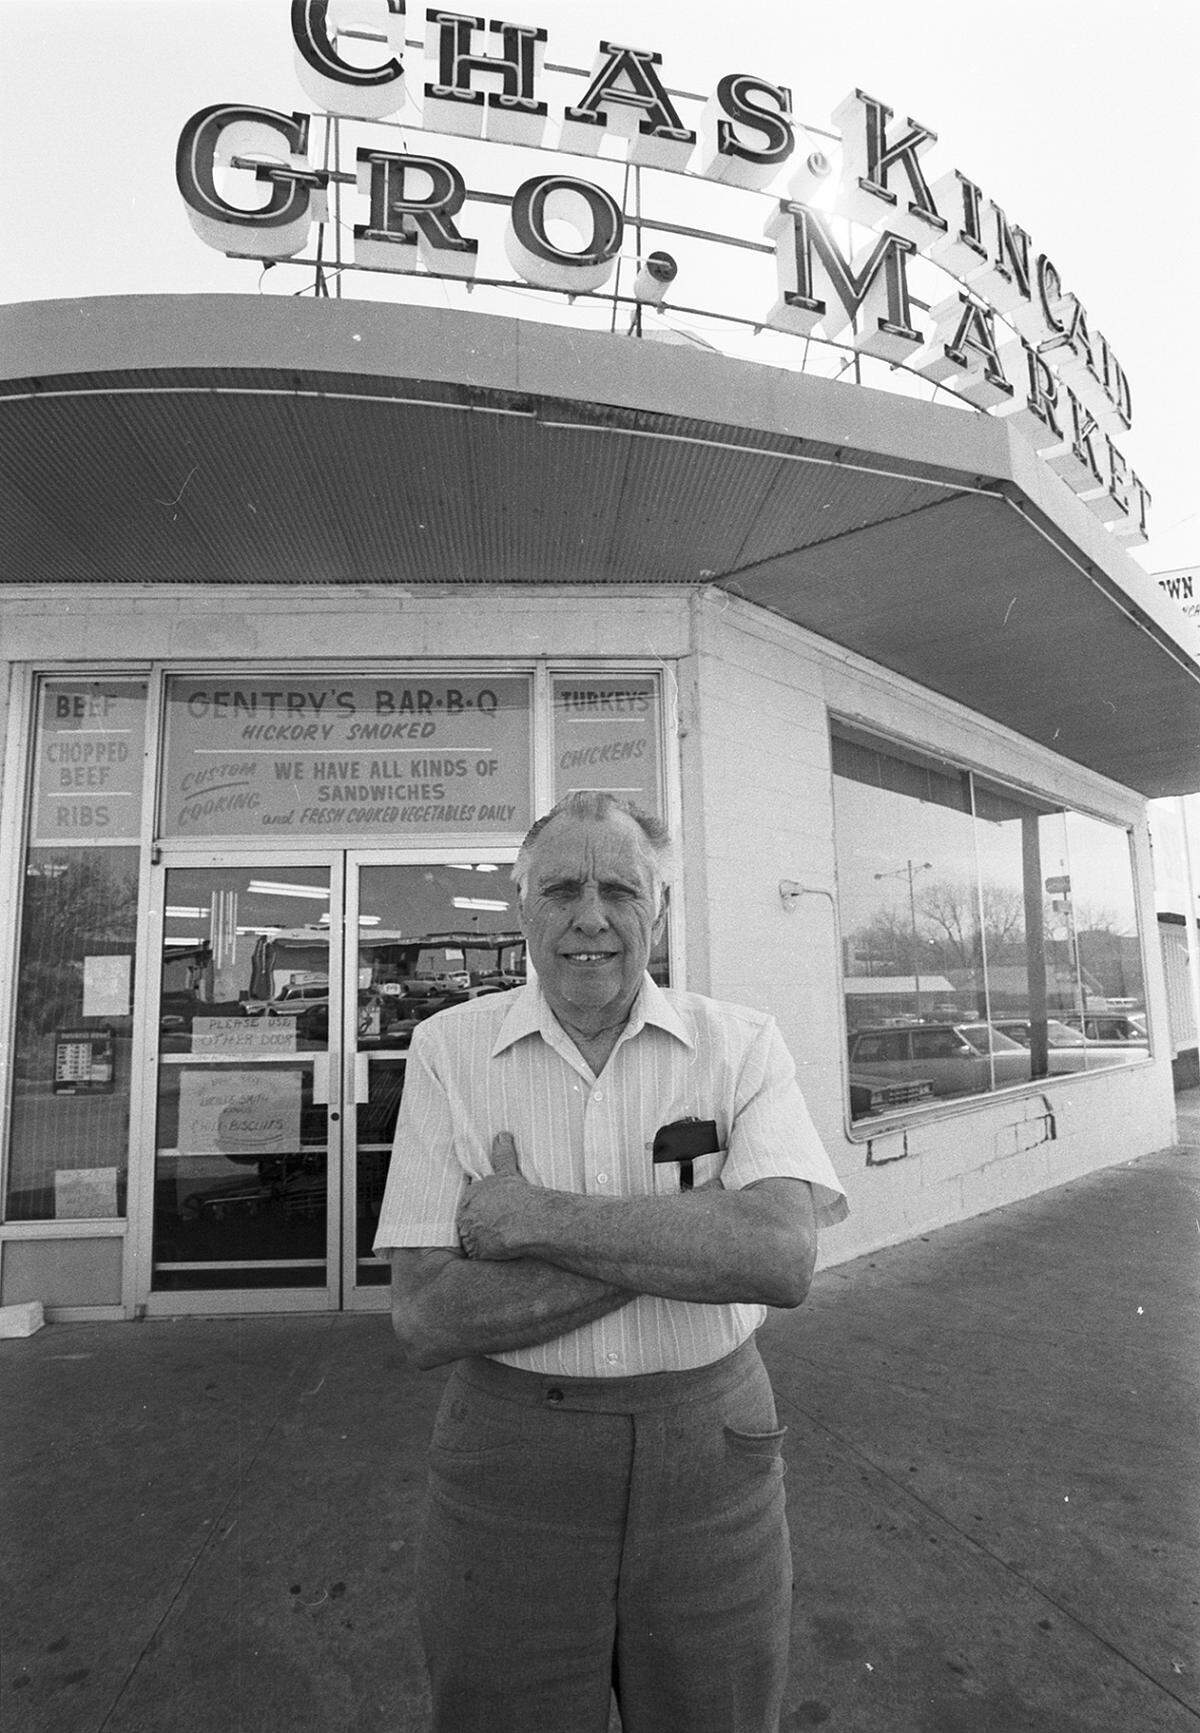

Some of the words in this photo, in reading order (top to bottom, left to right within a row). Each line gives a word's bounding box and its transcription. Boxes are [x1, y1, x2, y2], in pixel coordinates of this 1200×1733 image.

[175, 103, 678, 283] GRO.
[780, 199, 1152, 542] MARKET
[187, 688, 356, 719] GENTRY'S
[242, 724, 334, 741] HICKORY
[346, 722, 436, 740] SMOKED
[46, 741, 130, 763] CHOPPED
[559, 738, 647, 770] CHICKENS
[60, 766, 112, 787] BEEF
[274, 762, 303, 779] WE
[313, 762, 361, 779] HAVE
[370, 761, 402, 779] ALL
[411, 760, 467, 778] KINDS
[476, 760, 498, 776] OF
[318, 783, 445, 802] SANDWICHES
[56, 805, 111, 828] RIBS
[177, 792, 261, 828] COOKING
[300, 807, 346, 824] FRESH
[347, 806, 399, 823] COOKED
[400, 805, 476, 822] VEGETABLES
[478, 804, 516, 821] DAILY
